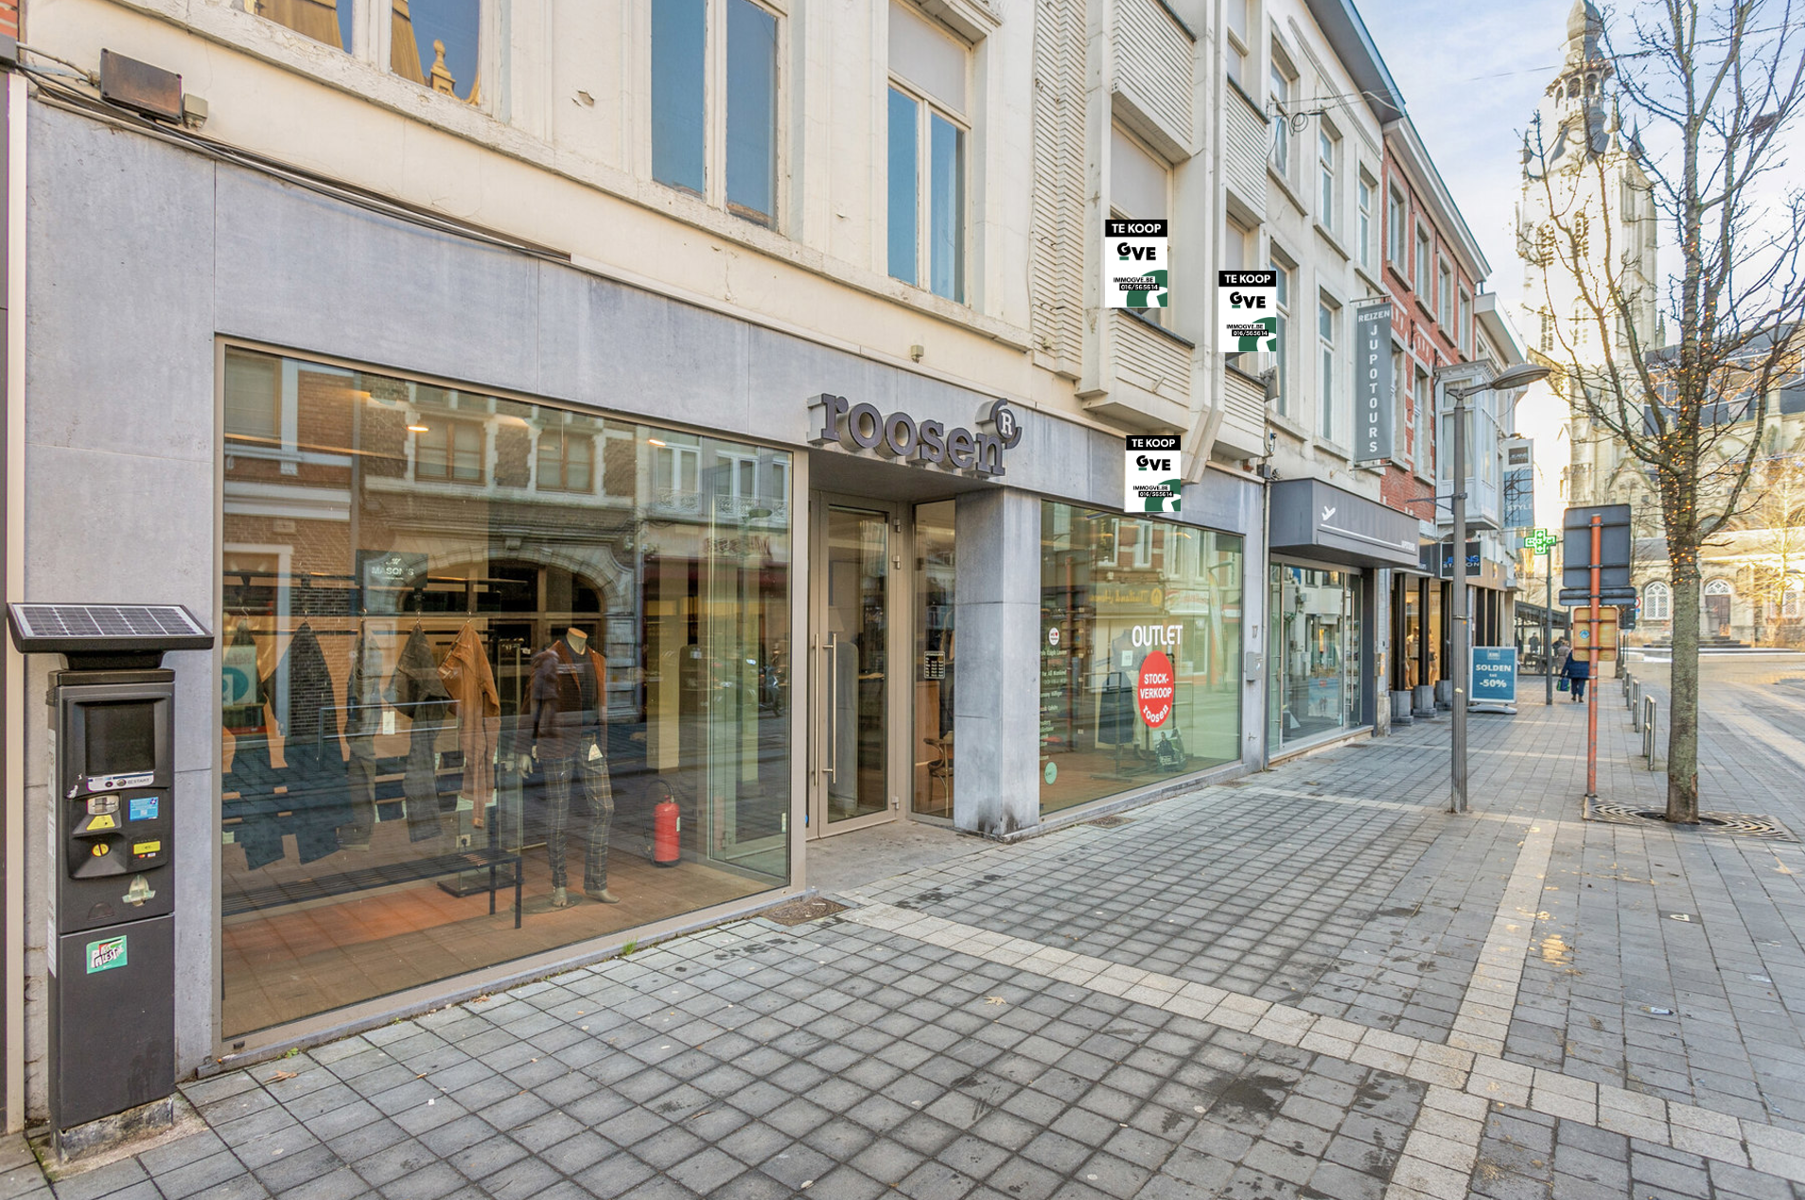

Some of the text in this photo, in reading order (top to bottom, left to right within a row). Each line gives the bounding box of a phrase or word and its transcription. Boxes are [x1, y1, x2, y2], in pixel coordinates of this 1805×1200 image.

[1111, 223, 1161, 233] TE KOOP
[1116, 241, 1157, 261] GVE
[1224, 274, 1271, 284] TE KOOP
[1229, 291, 1266, 309] GVE
[1358, 310, 1391, 322] REIZEN
[1369, 324, 1378, 453] JUPOTOURS
[807, 392, 1006, 476] roosen
[1131, 438, 1176, 448] TE KOOP
[1136, 454, 1171, 471] GVE
[1444, 554, 1480, 564] JENS
[1131, 624, 1183, 648] OUTLET
[1475, 664, 1512, 672] SOLDEN
[1144, 673, 1169, 685] STOCK-
[1479, 679, 1507, 688] -50%
[1140, 687, 1172, 700] VERKOOP
[1142, 704, 1169, 723] roosen
